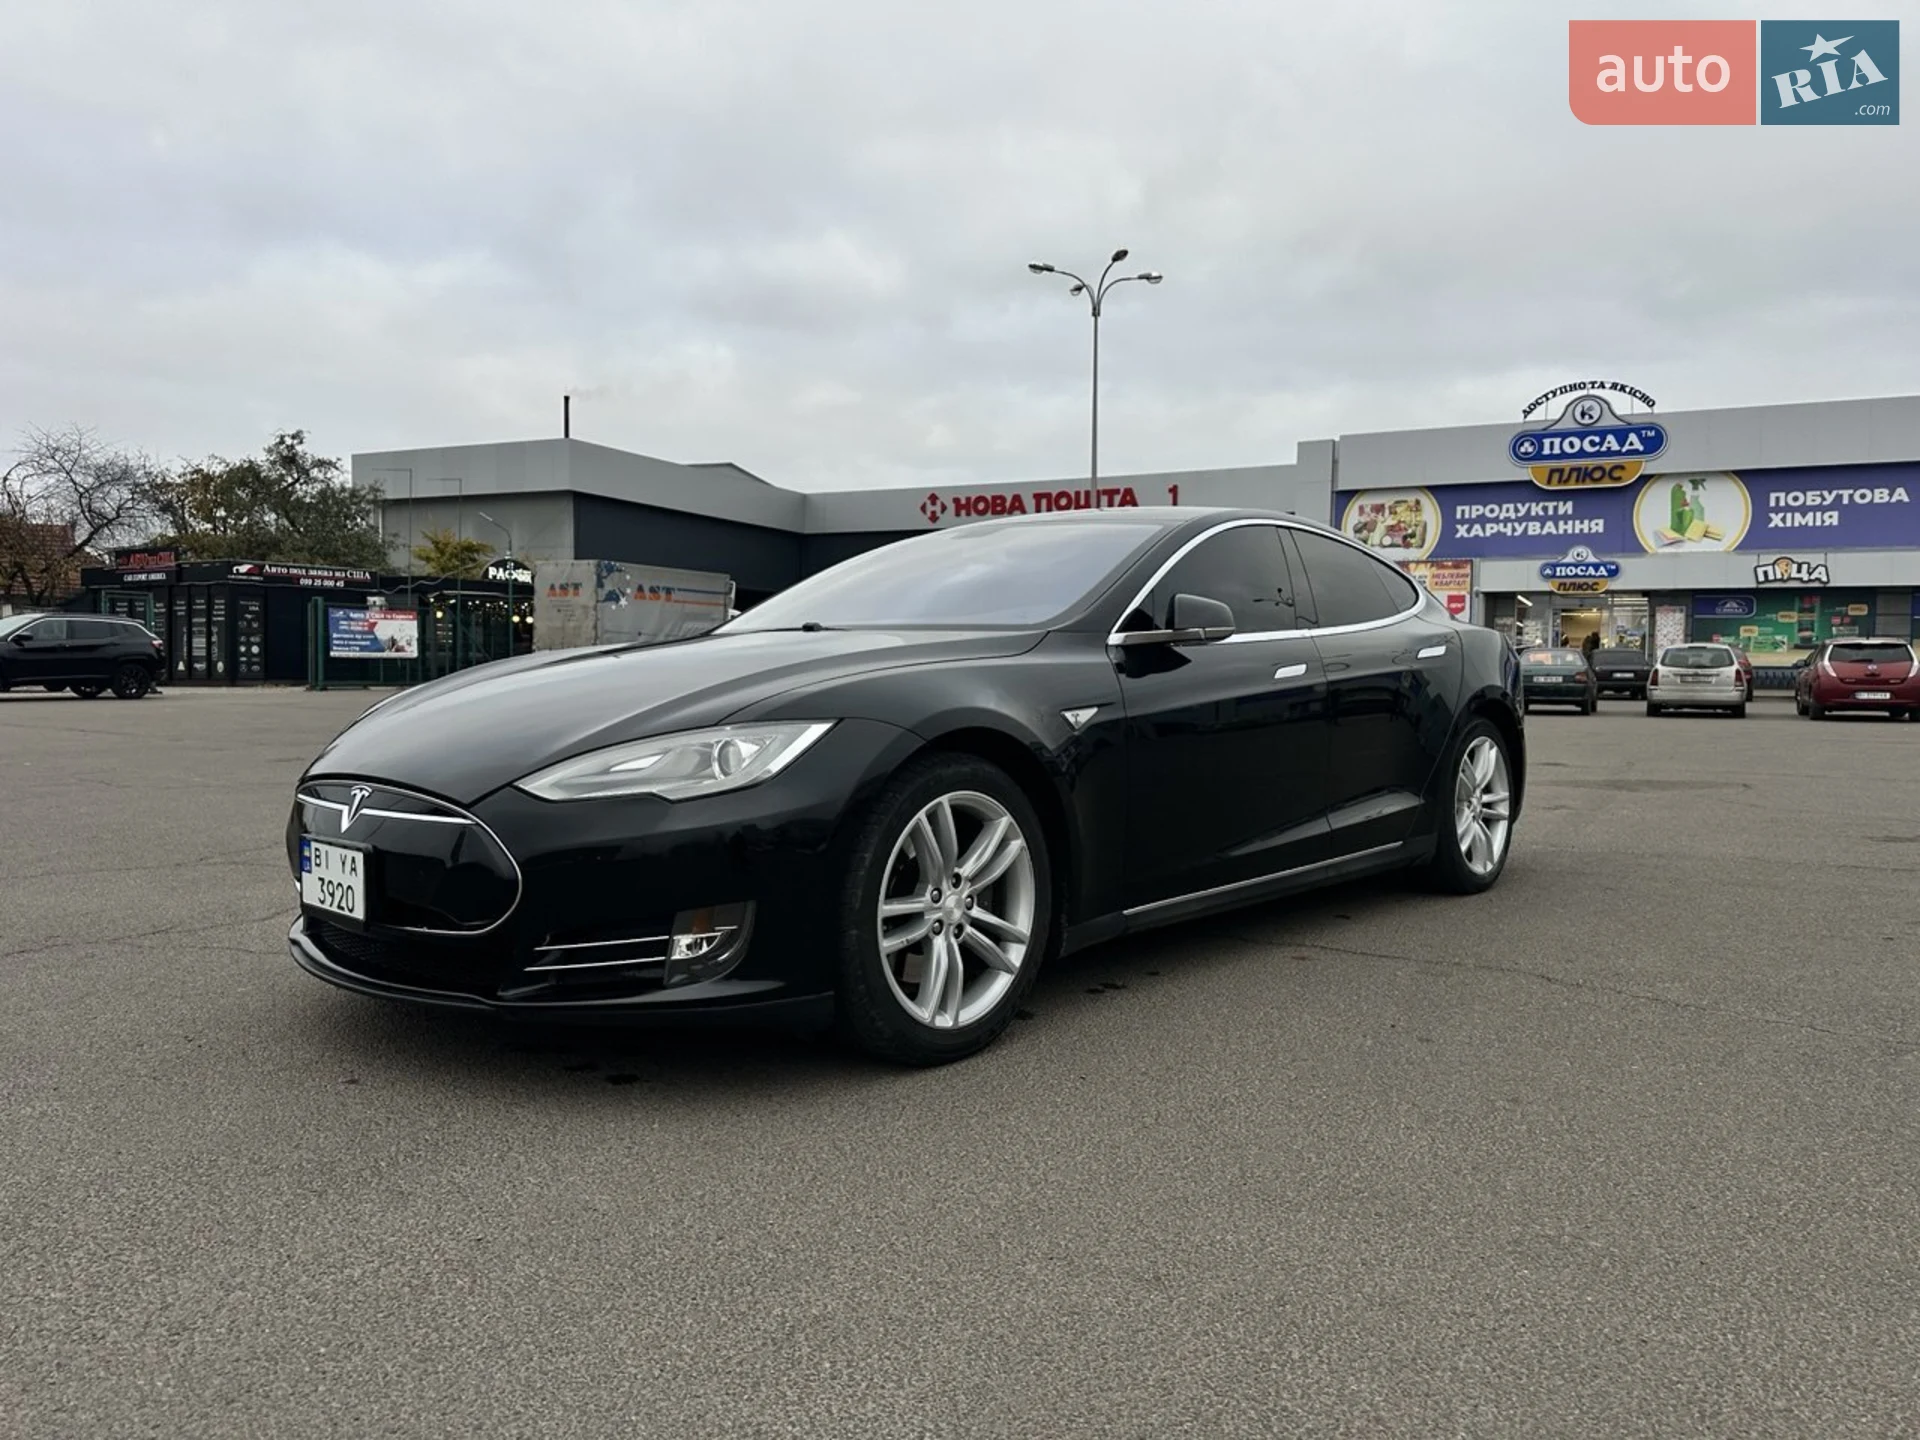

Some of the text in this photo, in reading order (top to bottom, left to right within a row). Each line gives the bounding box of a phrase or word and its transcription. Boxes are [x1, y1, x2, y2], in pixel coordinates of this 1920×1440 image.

[1522, 381, 1656, 419] ДОСТУПНО ТА ЯКІСНО
[1541, 432, 1644, 455] ПОСАД
[1546, 464, 1626, 485] ПЛЮС
[952, 484, 1179, 517] НОВА ПОШТА 1
[1768, 487, 1910, 507] ПОБУТОВА
[1455, 501, 1574, 520] ПРОДУКТИ
[1767, 510, 1839, 528] ХІМІЯ
[1454, 519, 1605, 538] ХАРЧУВАННЯ
[263, 564, 288, 574] Авто
[347, 570, 371, 580] США
[1555, 565, 1608, 577] ПОСАД
[547, 582, 582, 597] AST
[634, 584, 675, 601] AST
[1557, 581, 1600, 592] ПЛЮС
[314, 847, 358, 877] BI YA
[317, 876, 355, 914] 3920
